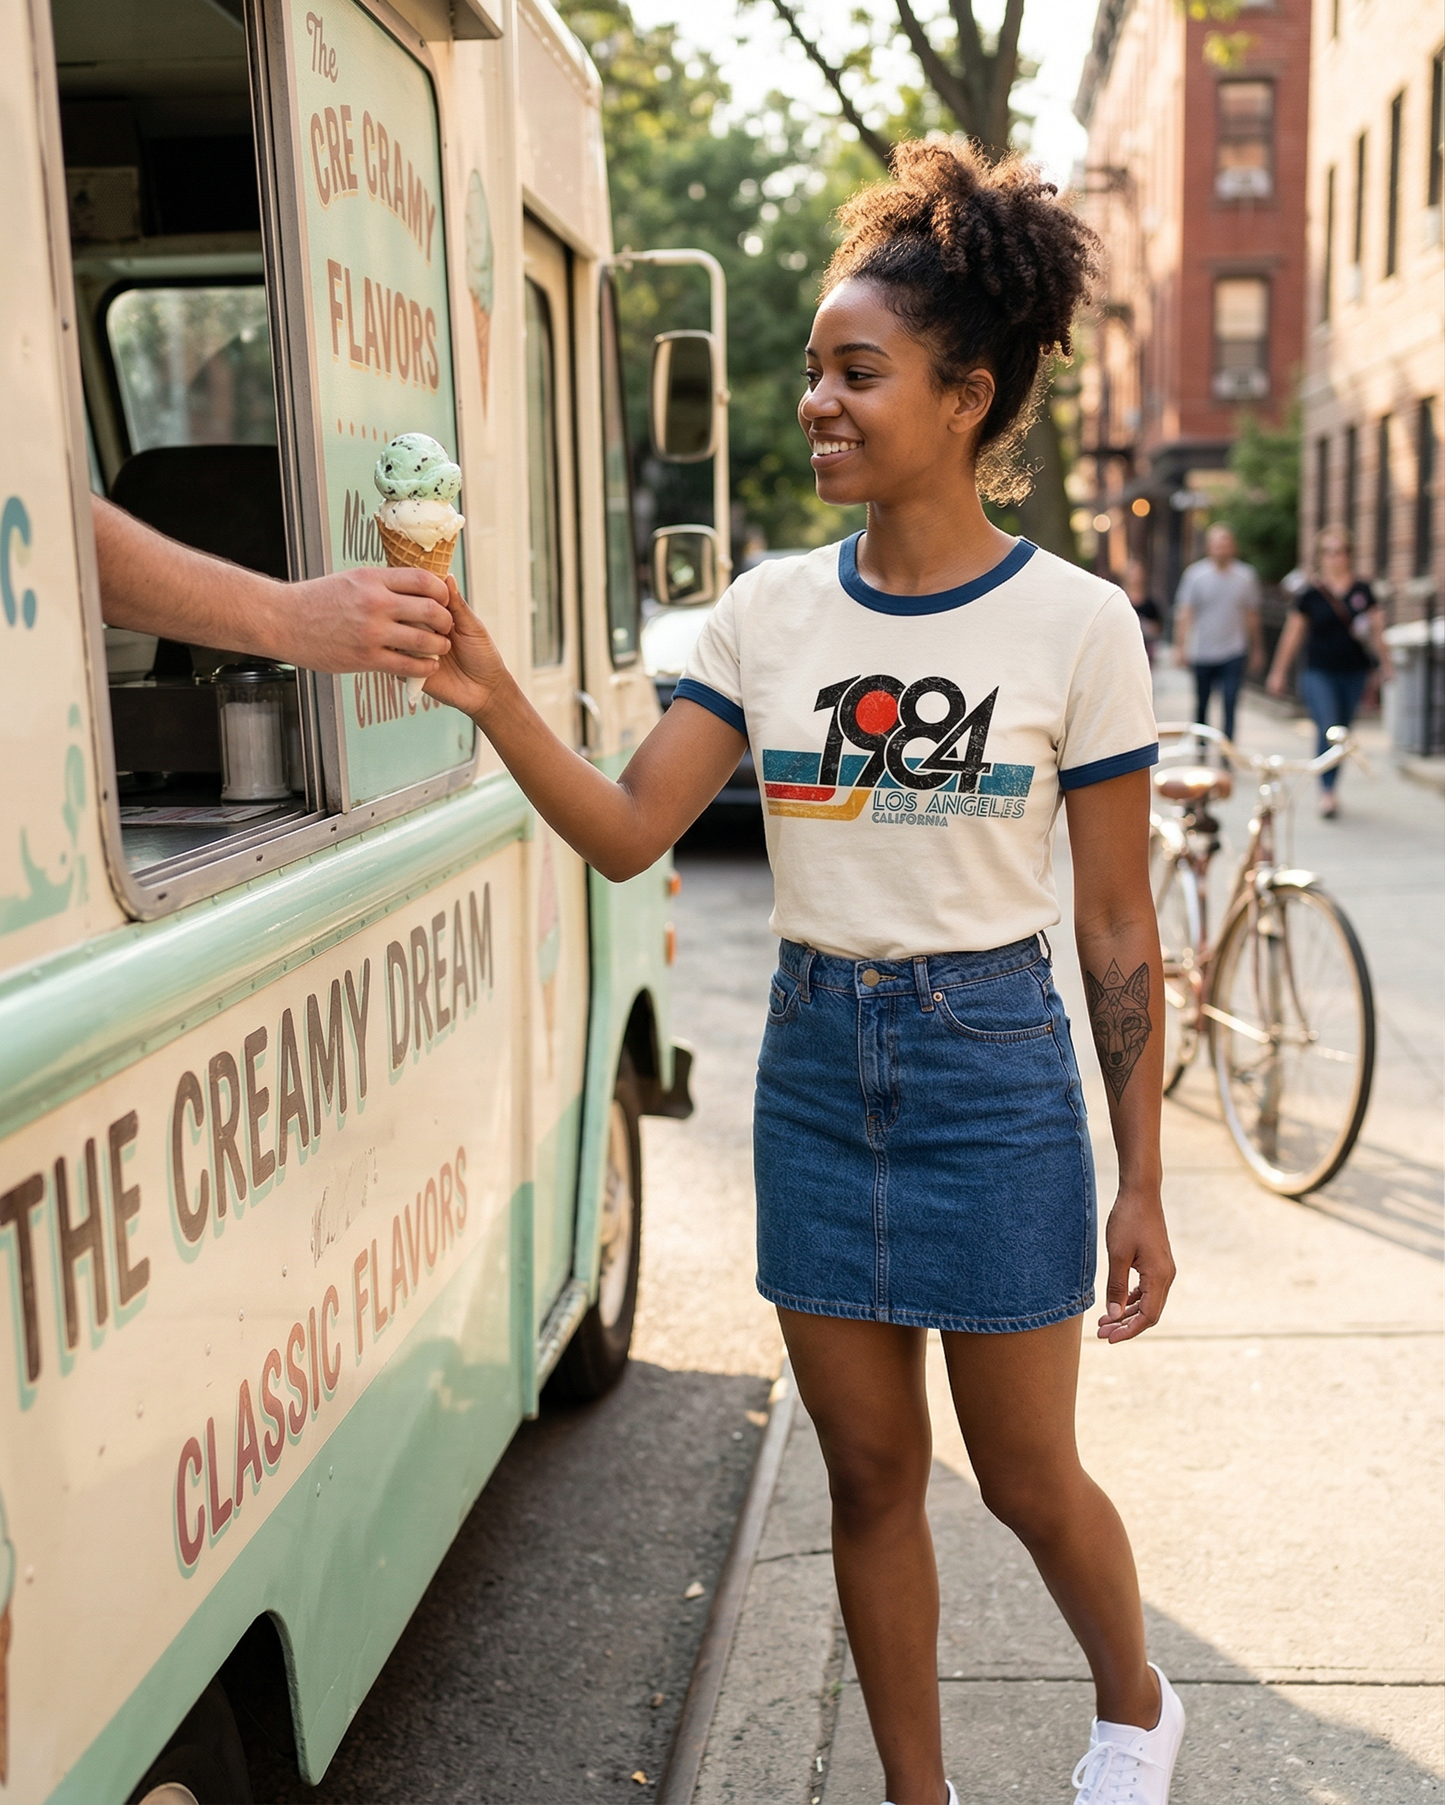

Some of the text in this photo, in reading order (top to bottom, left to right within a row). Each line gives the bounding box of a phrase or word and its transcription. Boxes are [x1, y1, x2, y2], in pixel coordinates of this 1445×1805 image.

[306, 11, 338, 83] The
[310, 104, 436, 264] CRE CRAMY
[327, 258, 440, 390] FLAVORS
[814, 674, 999, 793] 1984
[872, 812, 948, 827] CALIFORNIA
[873, 790, 1026, 819] LOS ANGELES
[0, 882, 494, 1383] THE CREAMY DREAM
[176, 1145, 467, 1566] CLASSIC FLAVORS
